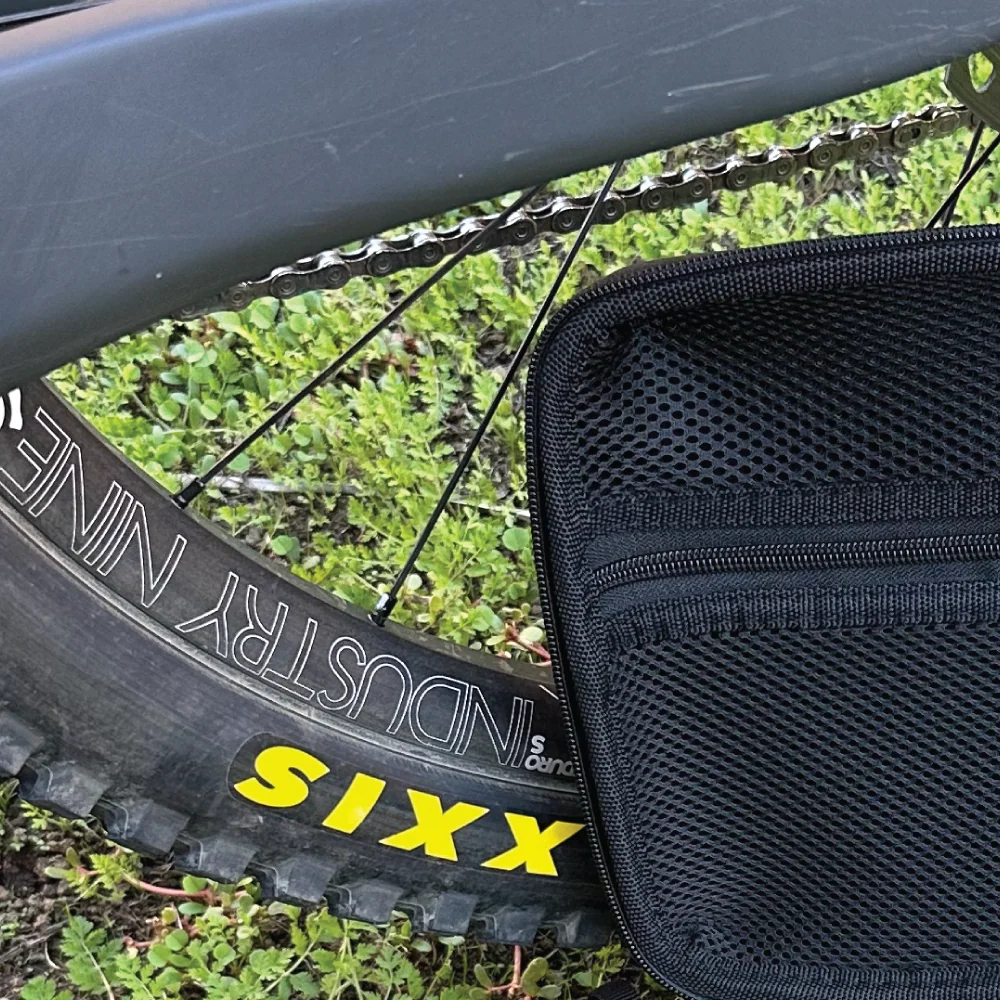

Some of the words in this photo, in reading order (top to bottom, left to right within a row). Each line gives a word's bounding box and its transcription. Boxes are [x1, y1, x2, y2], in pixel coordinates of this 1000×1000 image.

[0, 406, 189, 609] NINE
[174, 571, 535, 769] INDUSTRY
[530, 734, 546, 755] S
